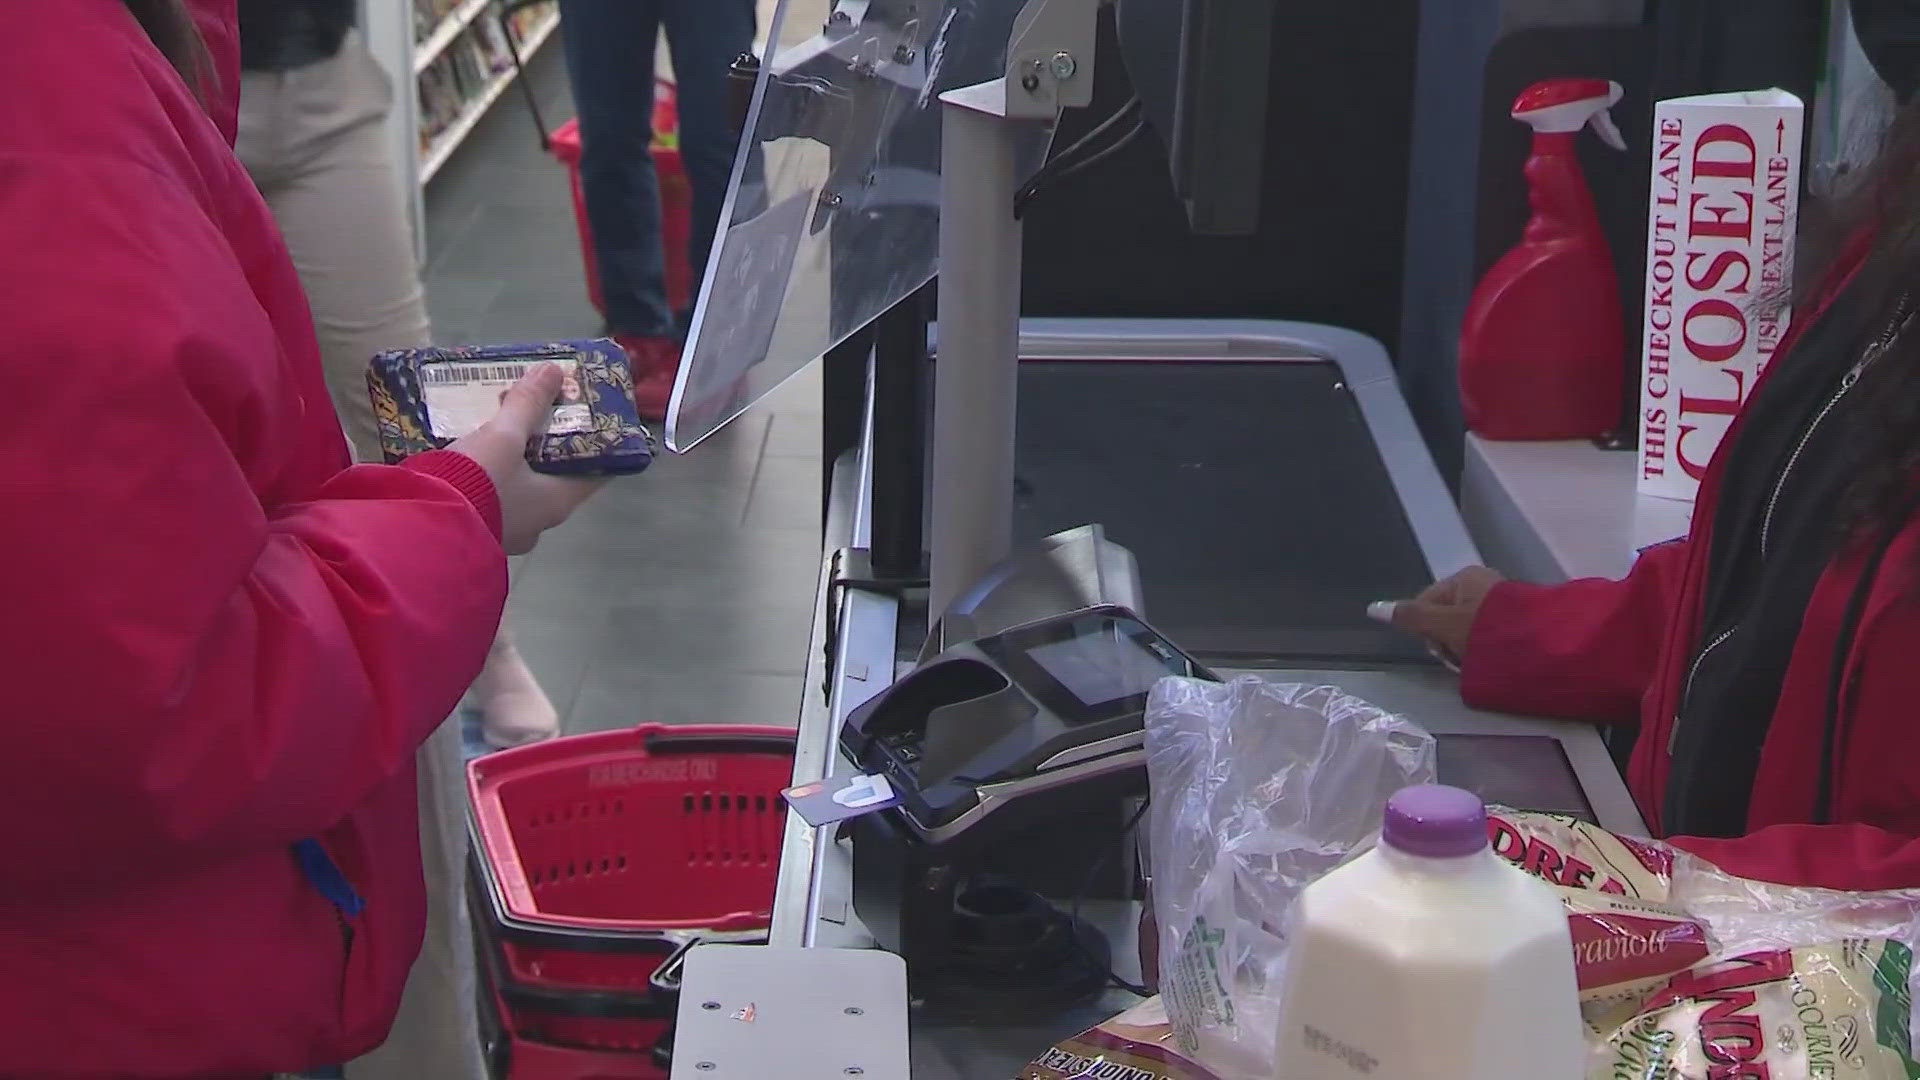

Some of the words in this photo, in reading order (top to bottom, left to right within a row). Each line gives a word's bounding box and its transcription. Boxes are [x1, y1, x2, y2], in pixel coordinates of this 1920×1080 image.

[1656, 117, 1683, 206] LANE
[1765, 157, 1789, 226] LANE
[1647, 214, 1677, 399] CHECKOUT
[1676, 123, 1757, 481] CLOSED
[1644, 408, 1667, 480] THIS
[1791, 988, 1836, 1080] GOURME
